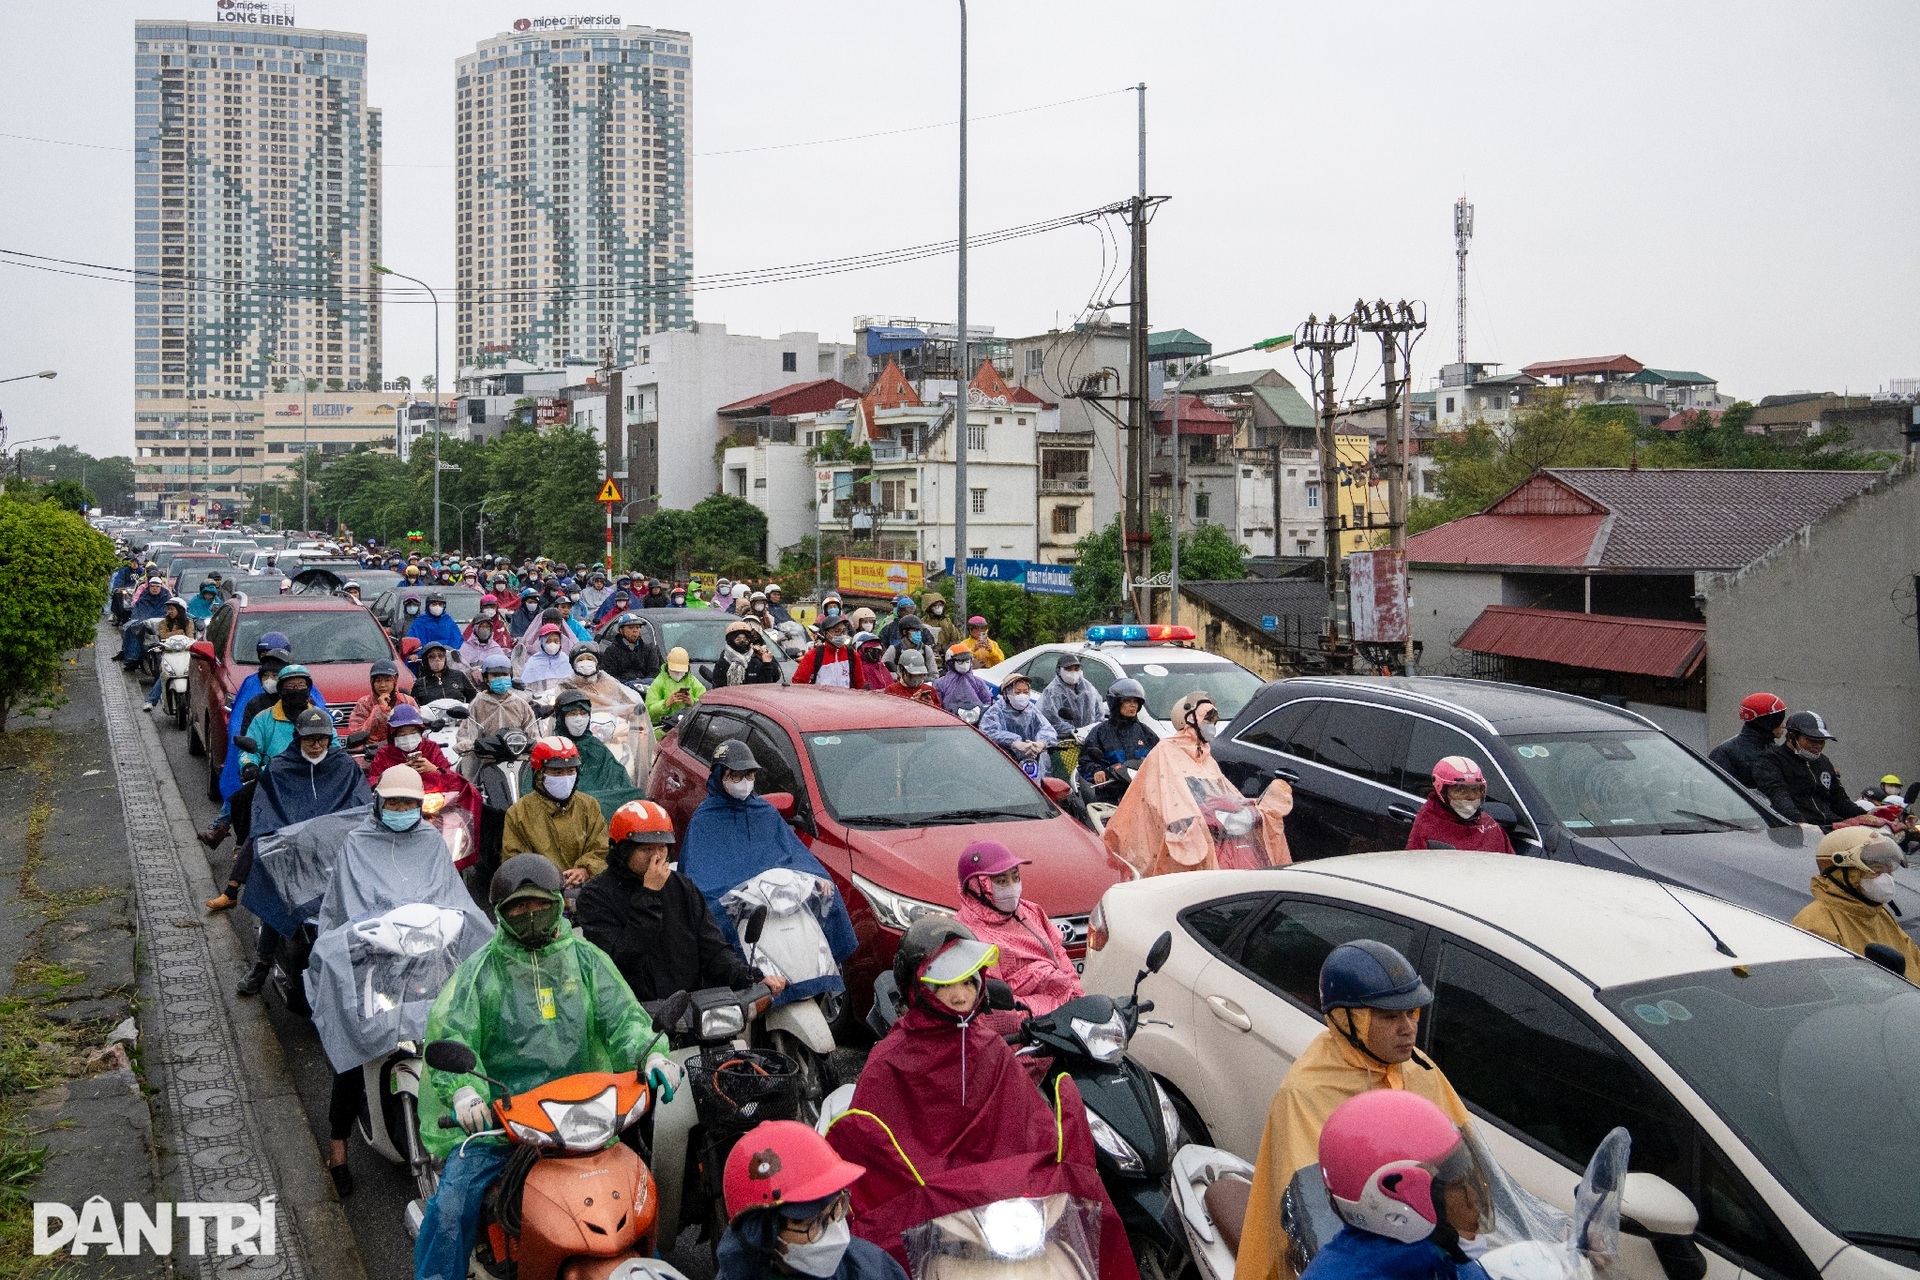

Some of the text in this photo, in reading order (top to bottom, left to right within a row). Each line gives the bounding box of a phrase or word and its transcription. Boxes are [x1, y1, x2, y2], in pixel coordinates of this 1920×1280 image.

[236, 2, 268, 10] mipec
[217, 11, 294, 26] LONG BIEN
[533, 15, 620, 28] mipec riverside
[989, 564, 999, 577] A
[579, 1168, 609, 1179] HONDA
